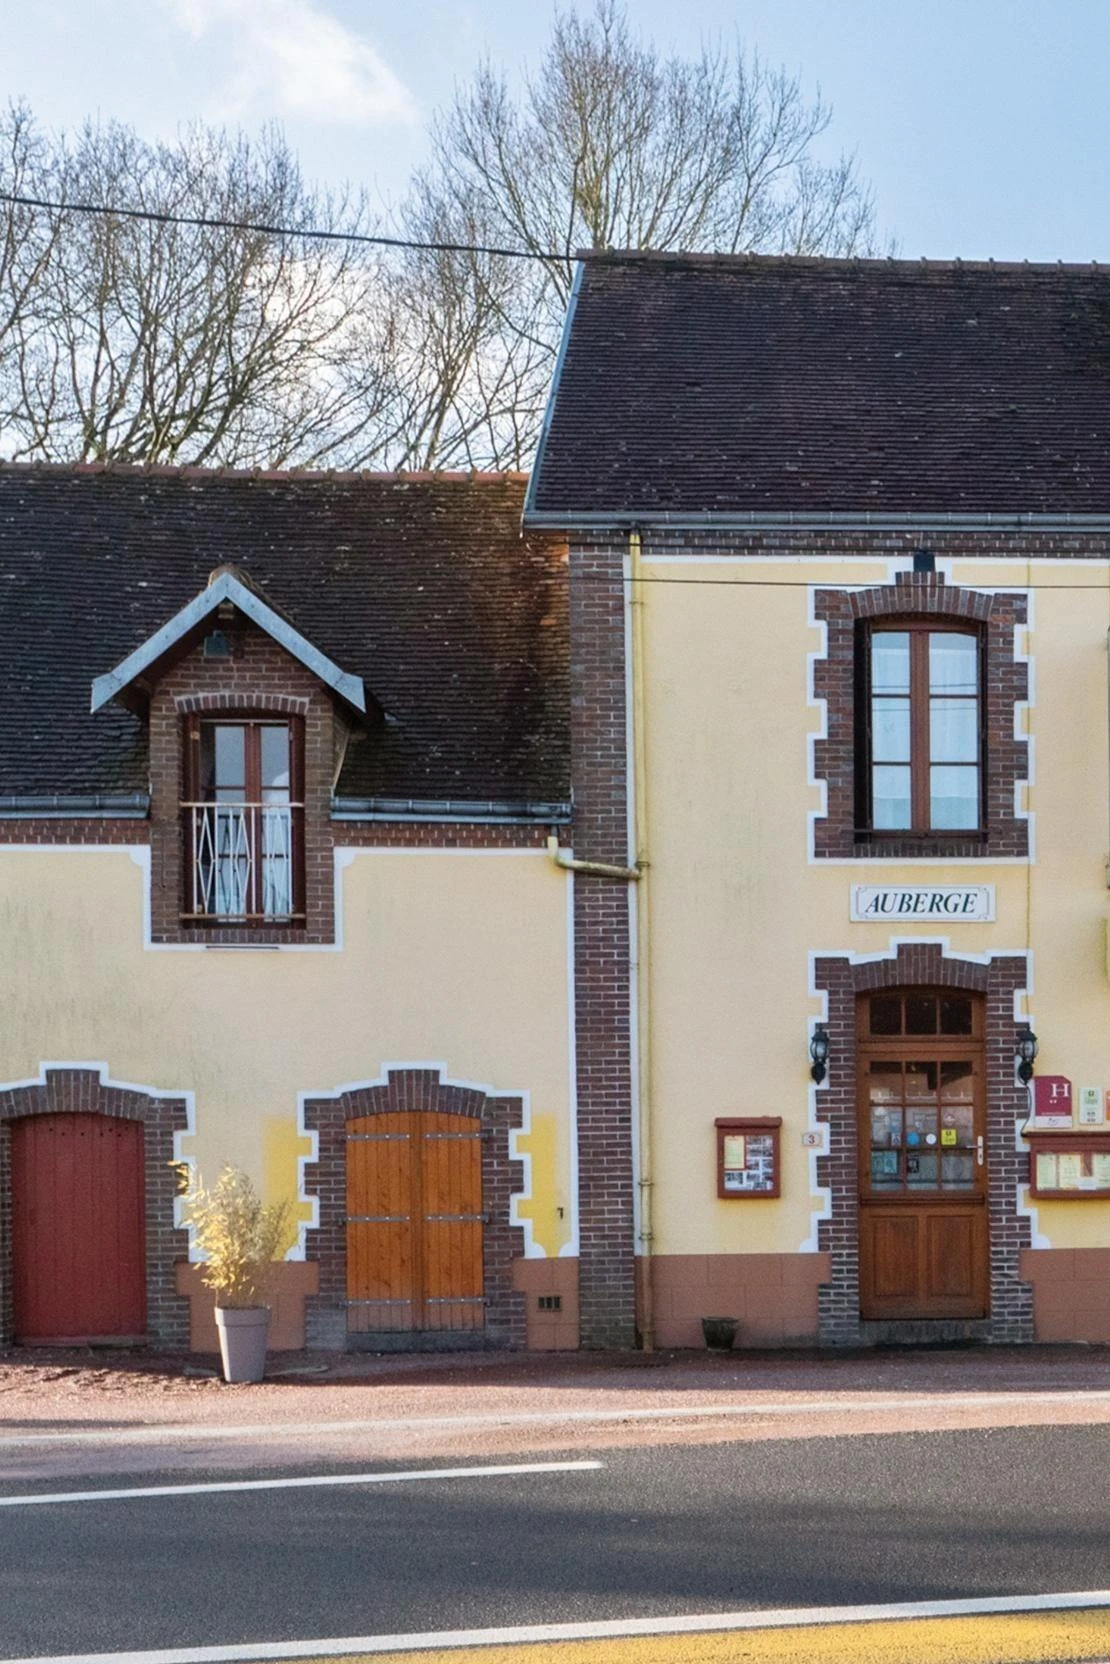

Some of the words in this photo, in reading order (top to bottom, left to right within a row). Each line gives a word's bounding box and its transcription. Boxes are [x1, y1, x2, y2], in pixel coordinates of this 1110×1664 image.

[865, 893, 977, 913] AUBERGE
[1051, 1083, 1069, 1098] H
[808, 1135, 816, 1144] 3
